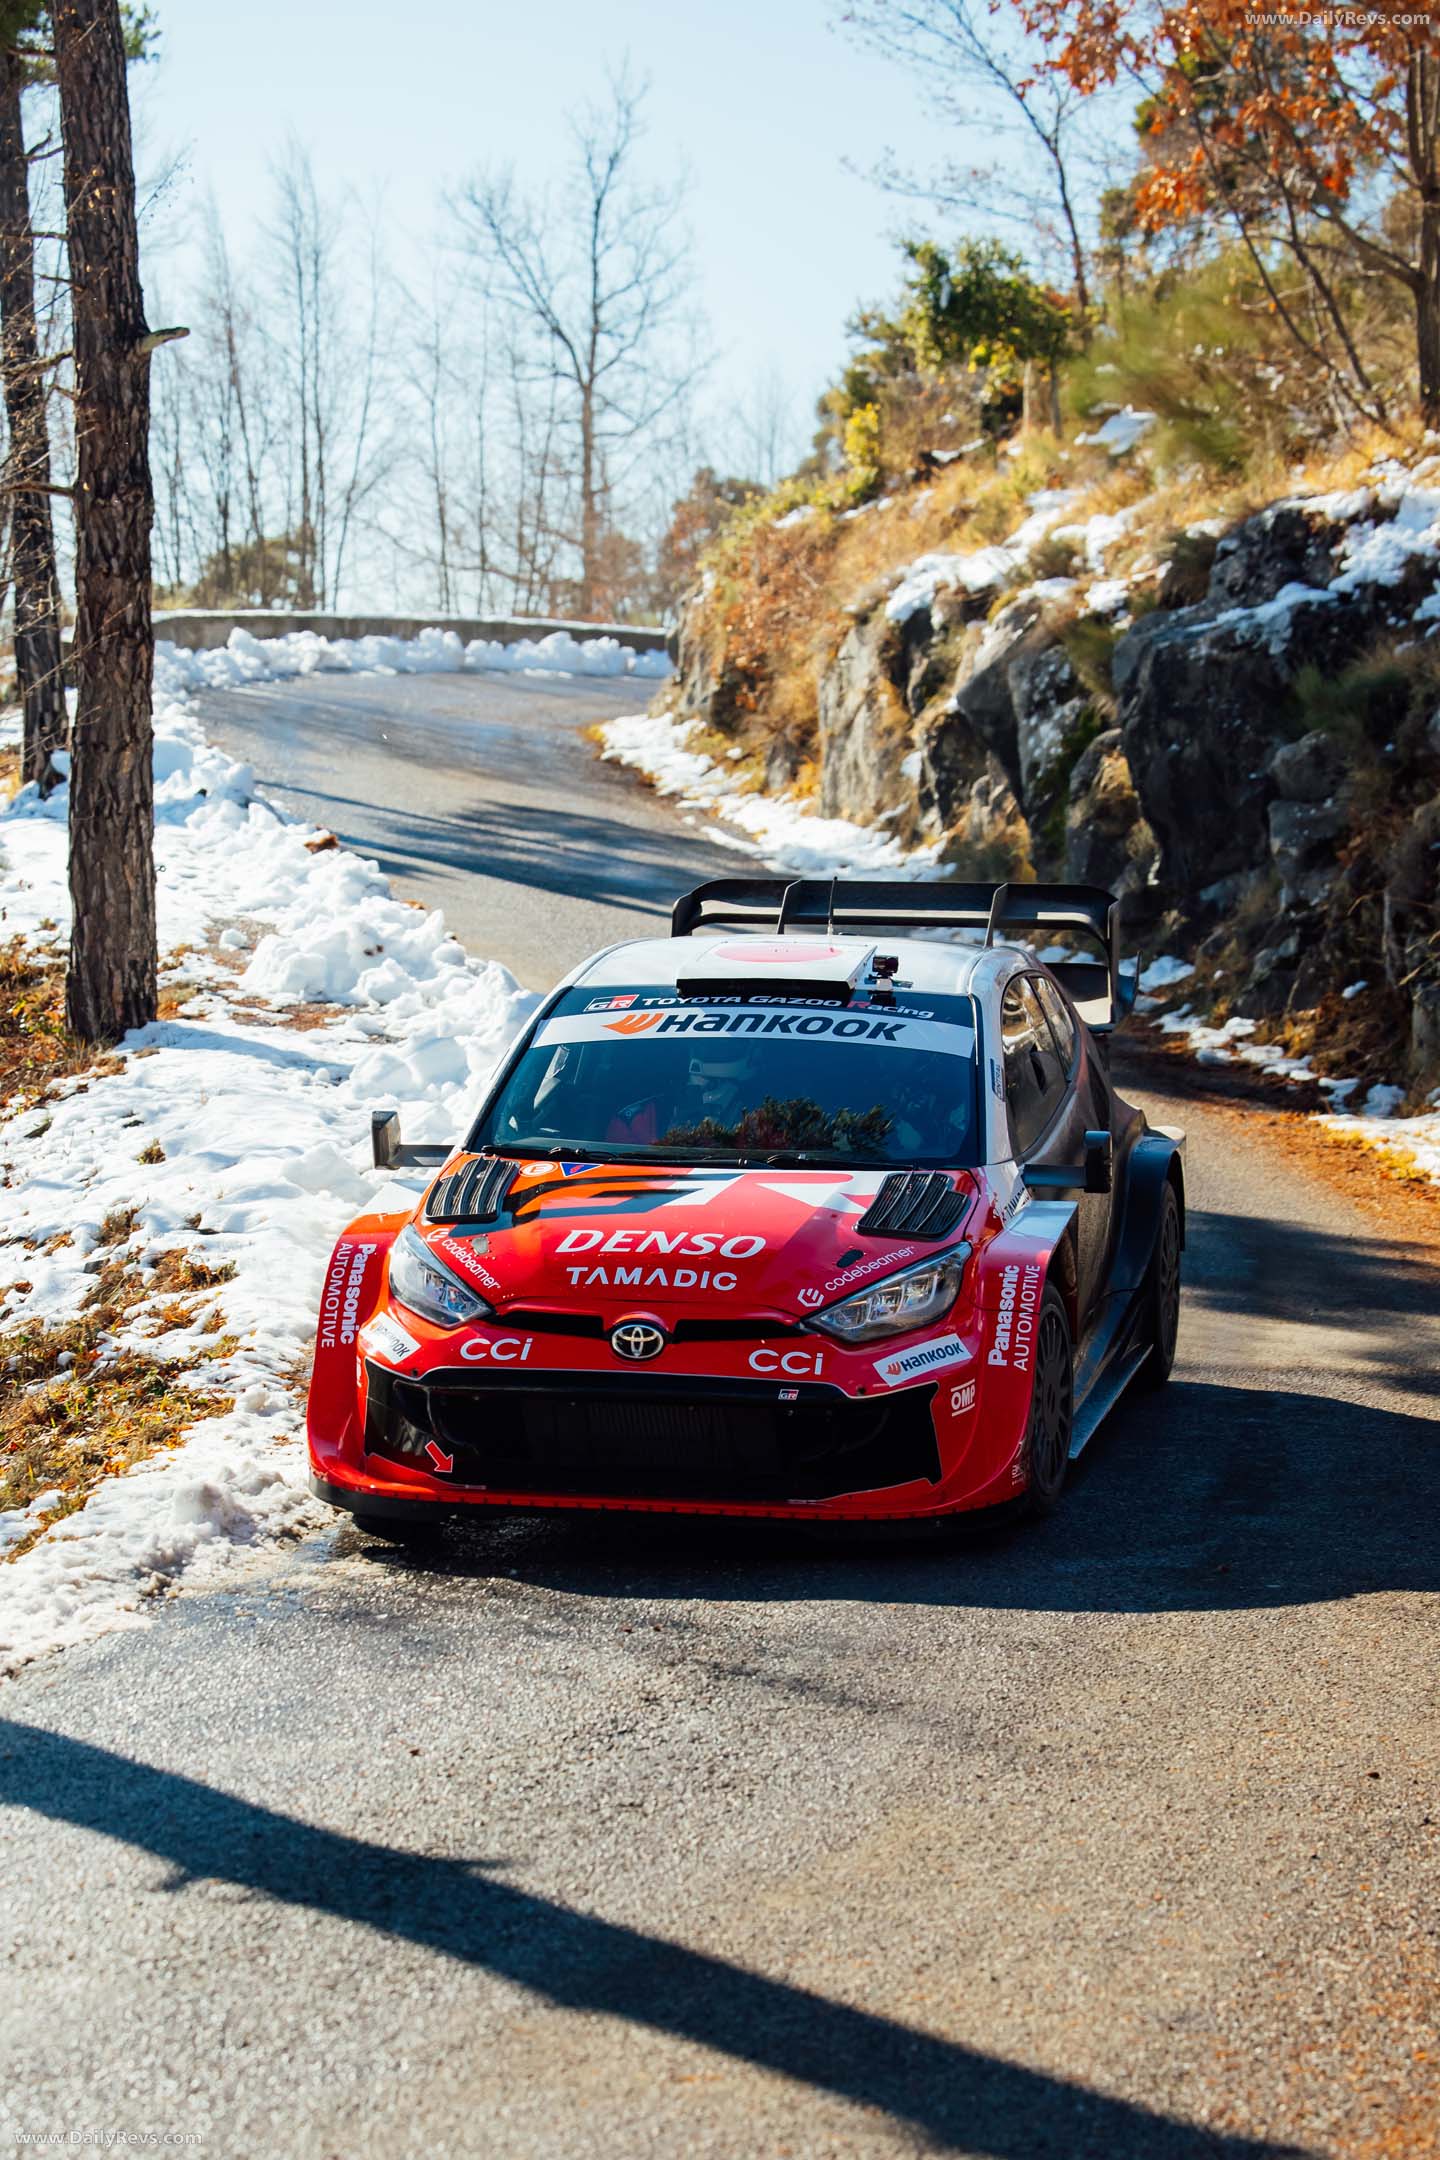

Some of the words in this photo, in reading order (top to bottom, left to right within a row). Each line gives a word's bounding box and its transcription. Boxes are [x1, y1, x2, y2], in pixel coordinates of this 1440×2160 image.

[586, 997, 636, 1011] GR
[642, 996, 741, 1006] TOYOTA
[748, 995, 841, 1007] GAZOO
[847, 1000, 935, 1019] Racing
[441, 1238, 500, 1289] codebeamer
[555, 1229, 766, 1259] DENSO
[566, 1266, 738, 1291] TAMADIC
[824, 1246, 913, 1291] codebeamer
[321, 1242, 353, 1348] AUTOMOTIVE
[340, 1243, 377, 1344] Panasonic
[987, 1264, 1020, 1367] Panasonic
[1013, 1264, 1041, 1372] AUTOMOTIVE
[951, 1384, 976, 1410] OMP
